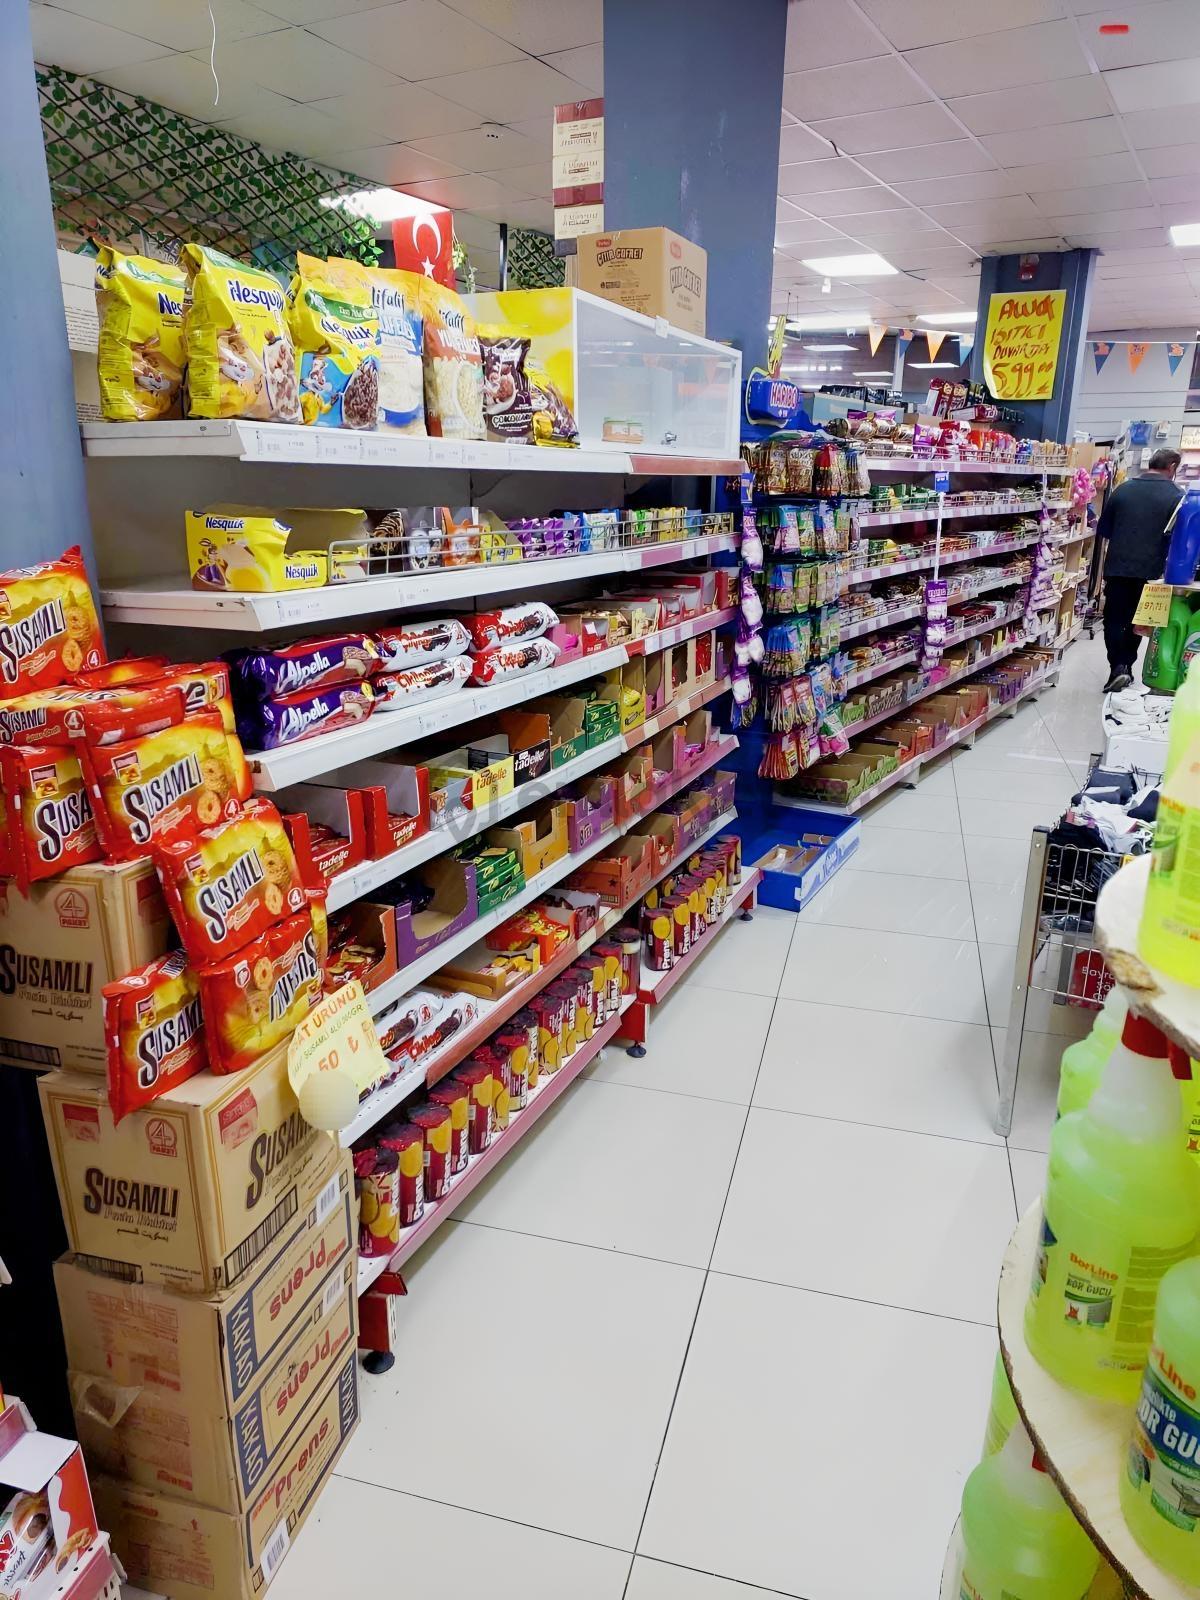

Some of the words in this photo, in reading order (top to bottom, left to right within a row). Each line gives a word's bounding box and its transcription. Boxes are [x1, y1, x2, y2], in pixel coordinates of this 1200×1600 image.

[228, 280, 285, 312] Nesquik
[205, 517, 244, 532] Nesquik
[286, 563, 319, 580] Nesquik
[284, 652, 330, 689] Alpella
[283, 699, 330, 736] Alpella
[476, 766, 508, 791] tadelle
[514, 746, 548, 772] tadelle
[122, 751, 203, 844] SUSAMLI
[34, 787, 94, 862] SUSA
[392, 820, 418, 842] tadelle
[318, 848, 350, 872] tadelle
[196, 848, 264, 943] SUSAMLI
[0, 944, 94, 995] SUSAMLI
[595, 992, 604, 1025] Prens
[84, 1167, 178, 1217] SUSAMLI
[269, 1239, 328, 1322] Prens
[1070, 1252, 1118, 1281] BorLine
[230, 1298, 252, 1390] KAKAO
[275, 1329, 330, 1417] Prens
[341, 1358, 356, 1432] KAKAO
[239, 1397, 264, 1485] KAKAO
[272, 1417, 329, 1509] Prens
